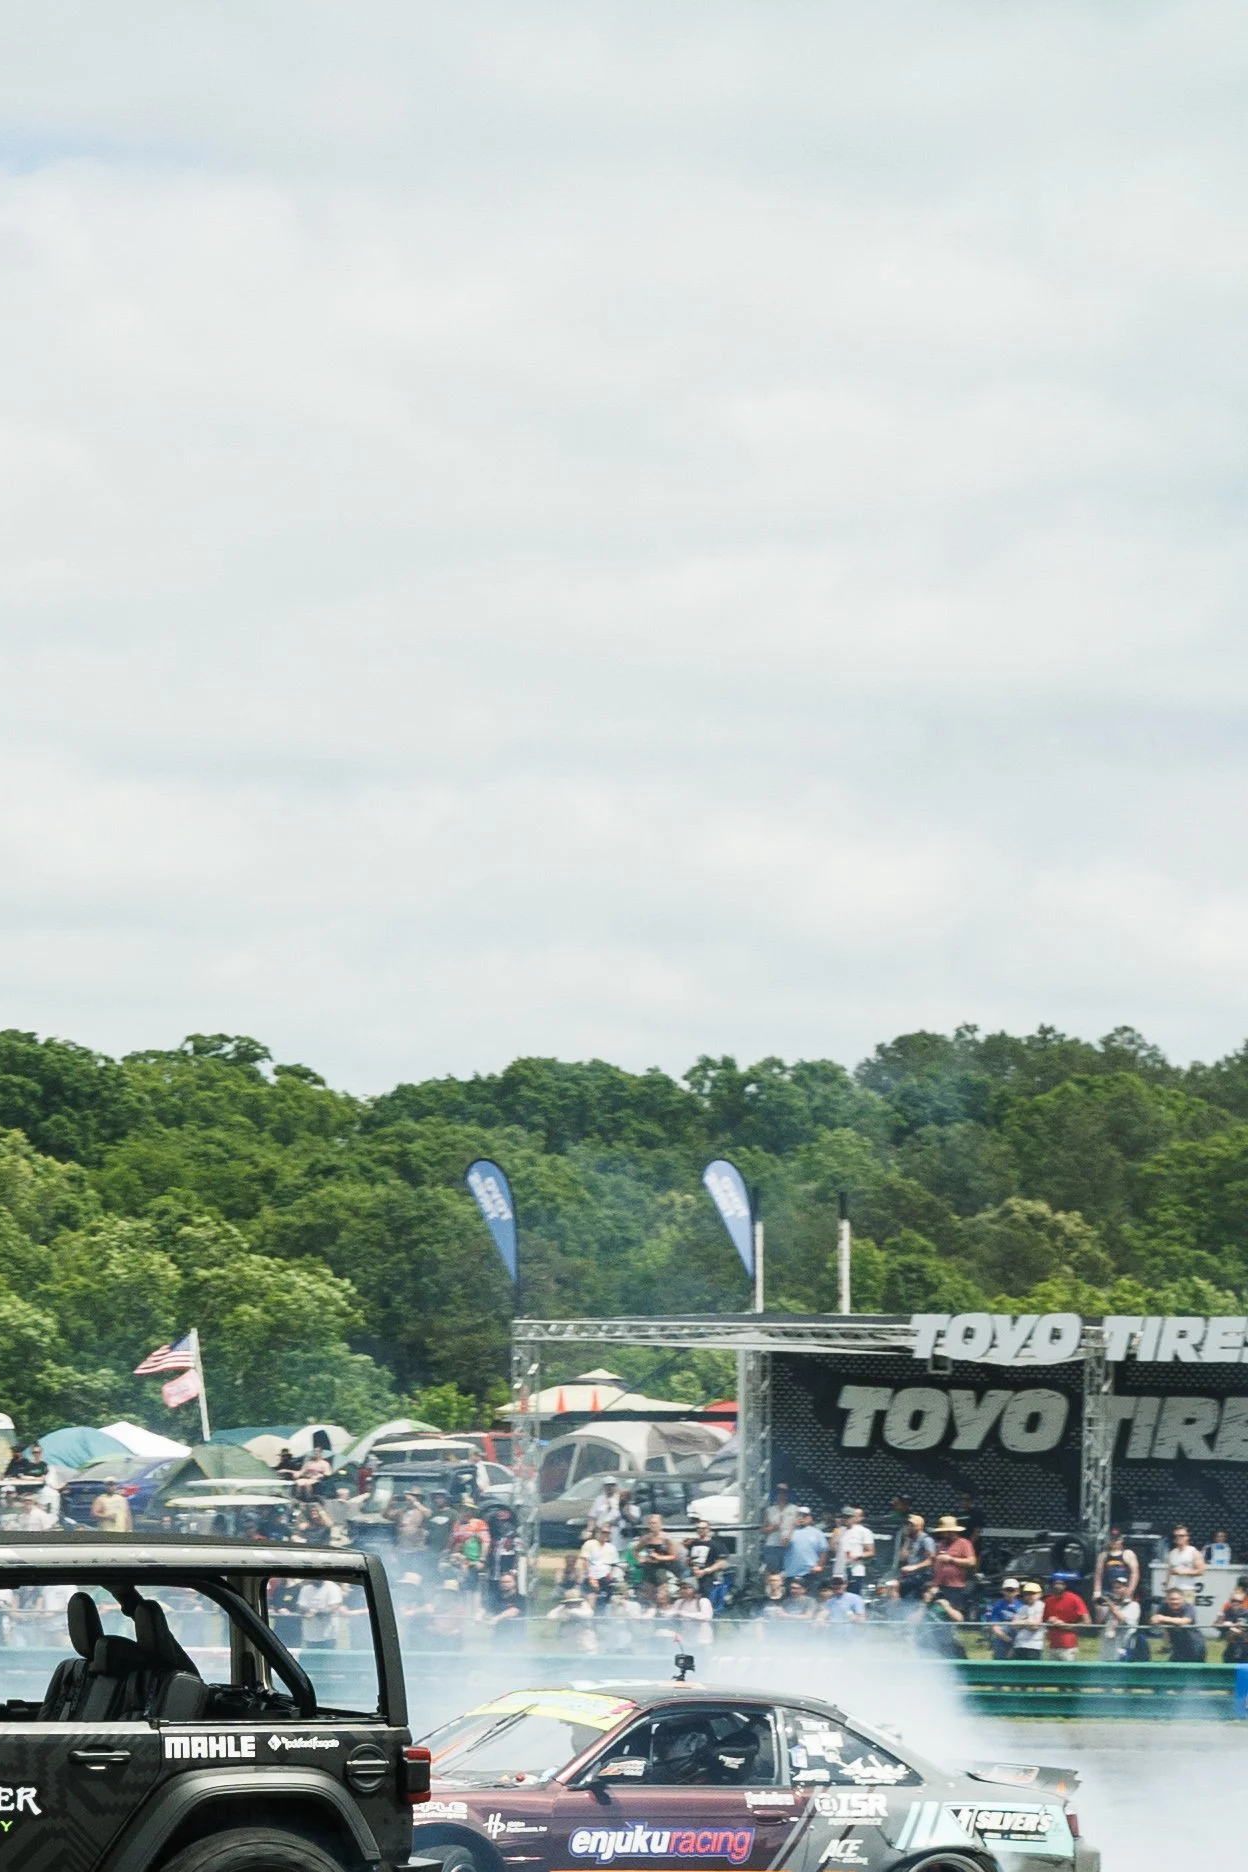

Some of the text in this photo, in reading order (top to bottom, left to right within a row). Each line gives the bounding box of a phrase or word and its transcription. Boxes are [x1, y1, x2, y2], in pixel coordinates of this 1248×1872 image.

[909, 1312, 1248, 1363] TOYO TIRE
[837, 1385, 1070, 1453] TOYO
[164, 1735, 256, 1759] MAHLE
[818, 1839, 864, 1864] ACE
